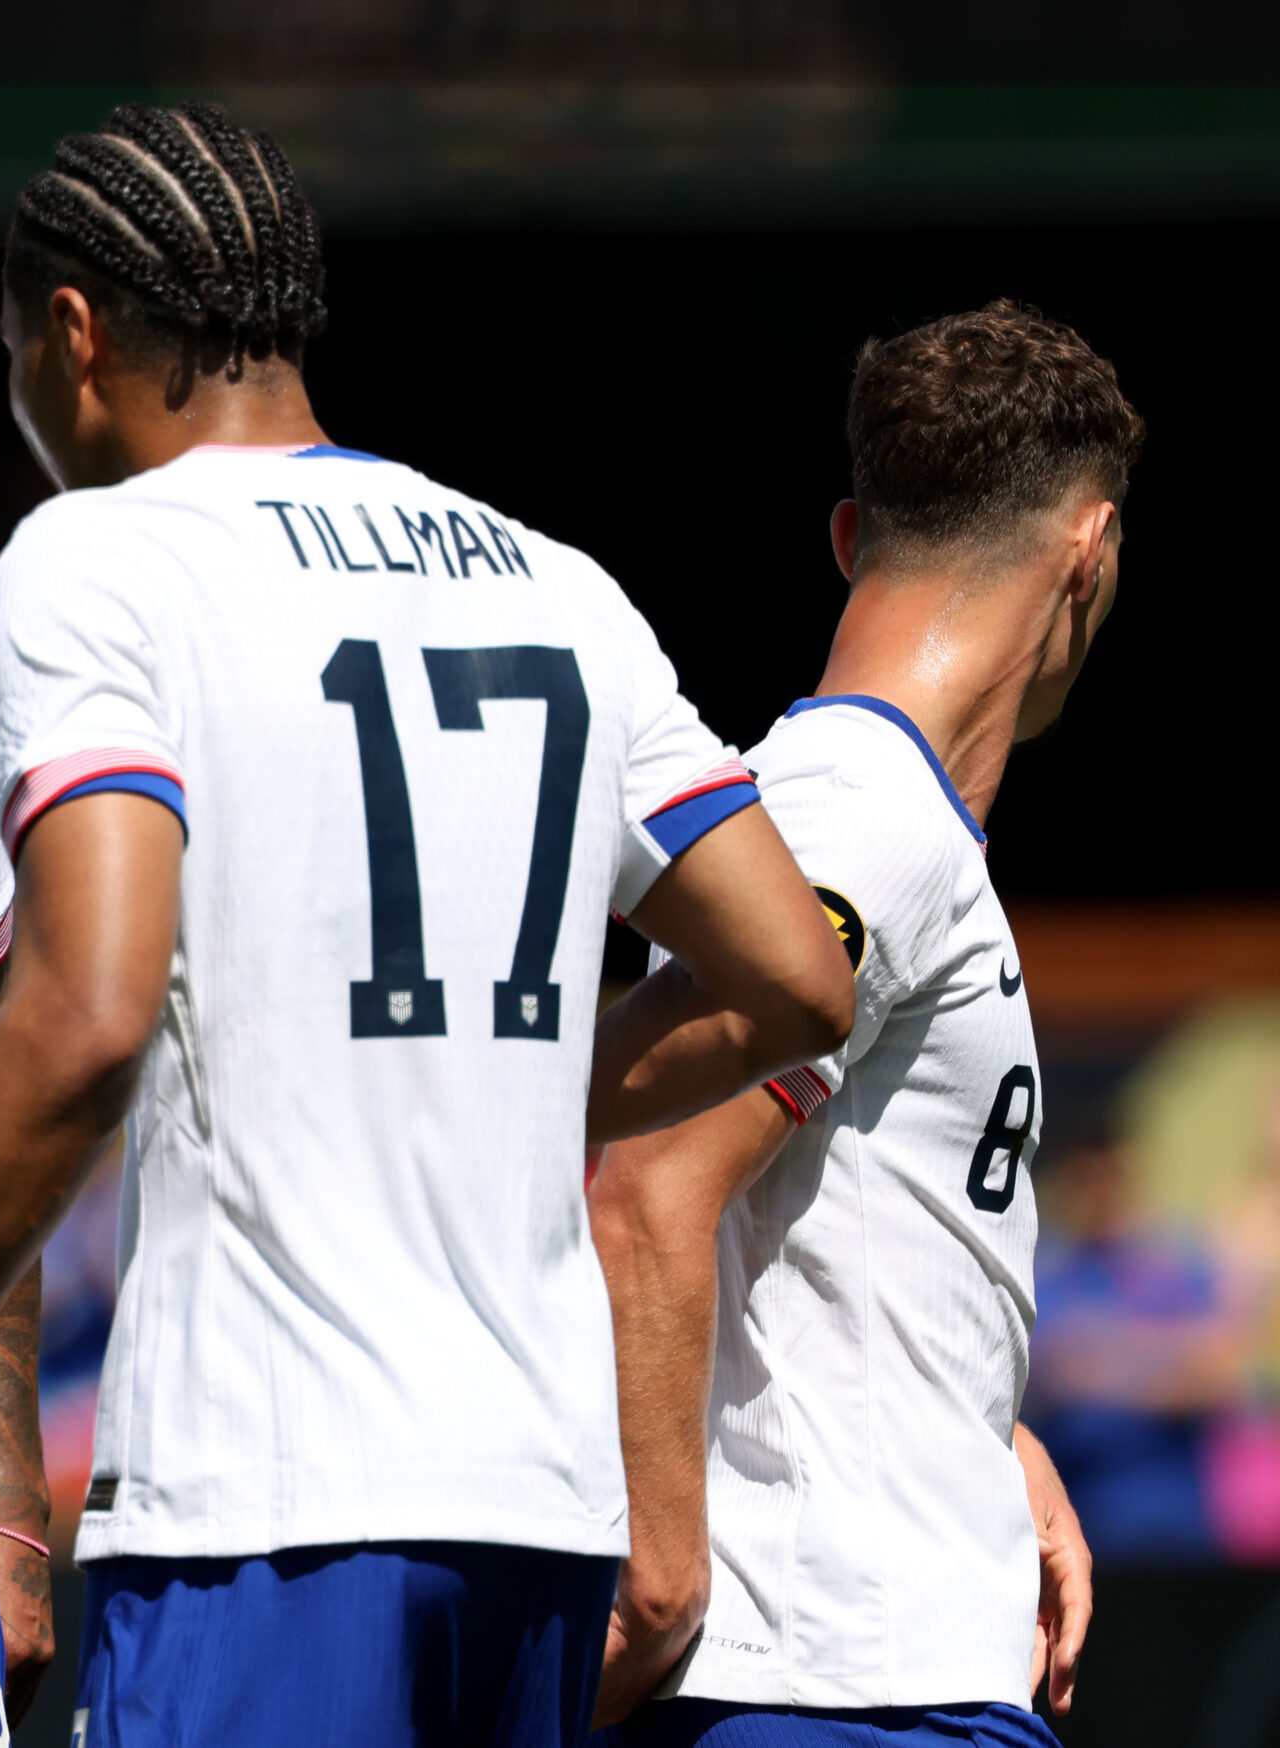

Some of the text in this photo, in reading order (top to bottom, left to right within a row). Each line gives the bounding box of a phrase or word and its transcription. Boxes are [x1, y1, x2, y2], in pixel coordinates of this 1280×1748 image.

[254, 500, 535, 582] TILLMAN
[320, 638, 591, 1042] 17
[965, 1064, 1036, 1214] 8
